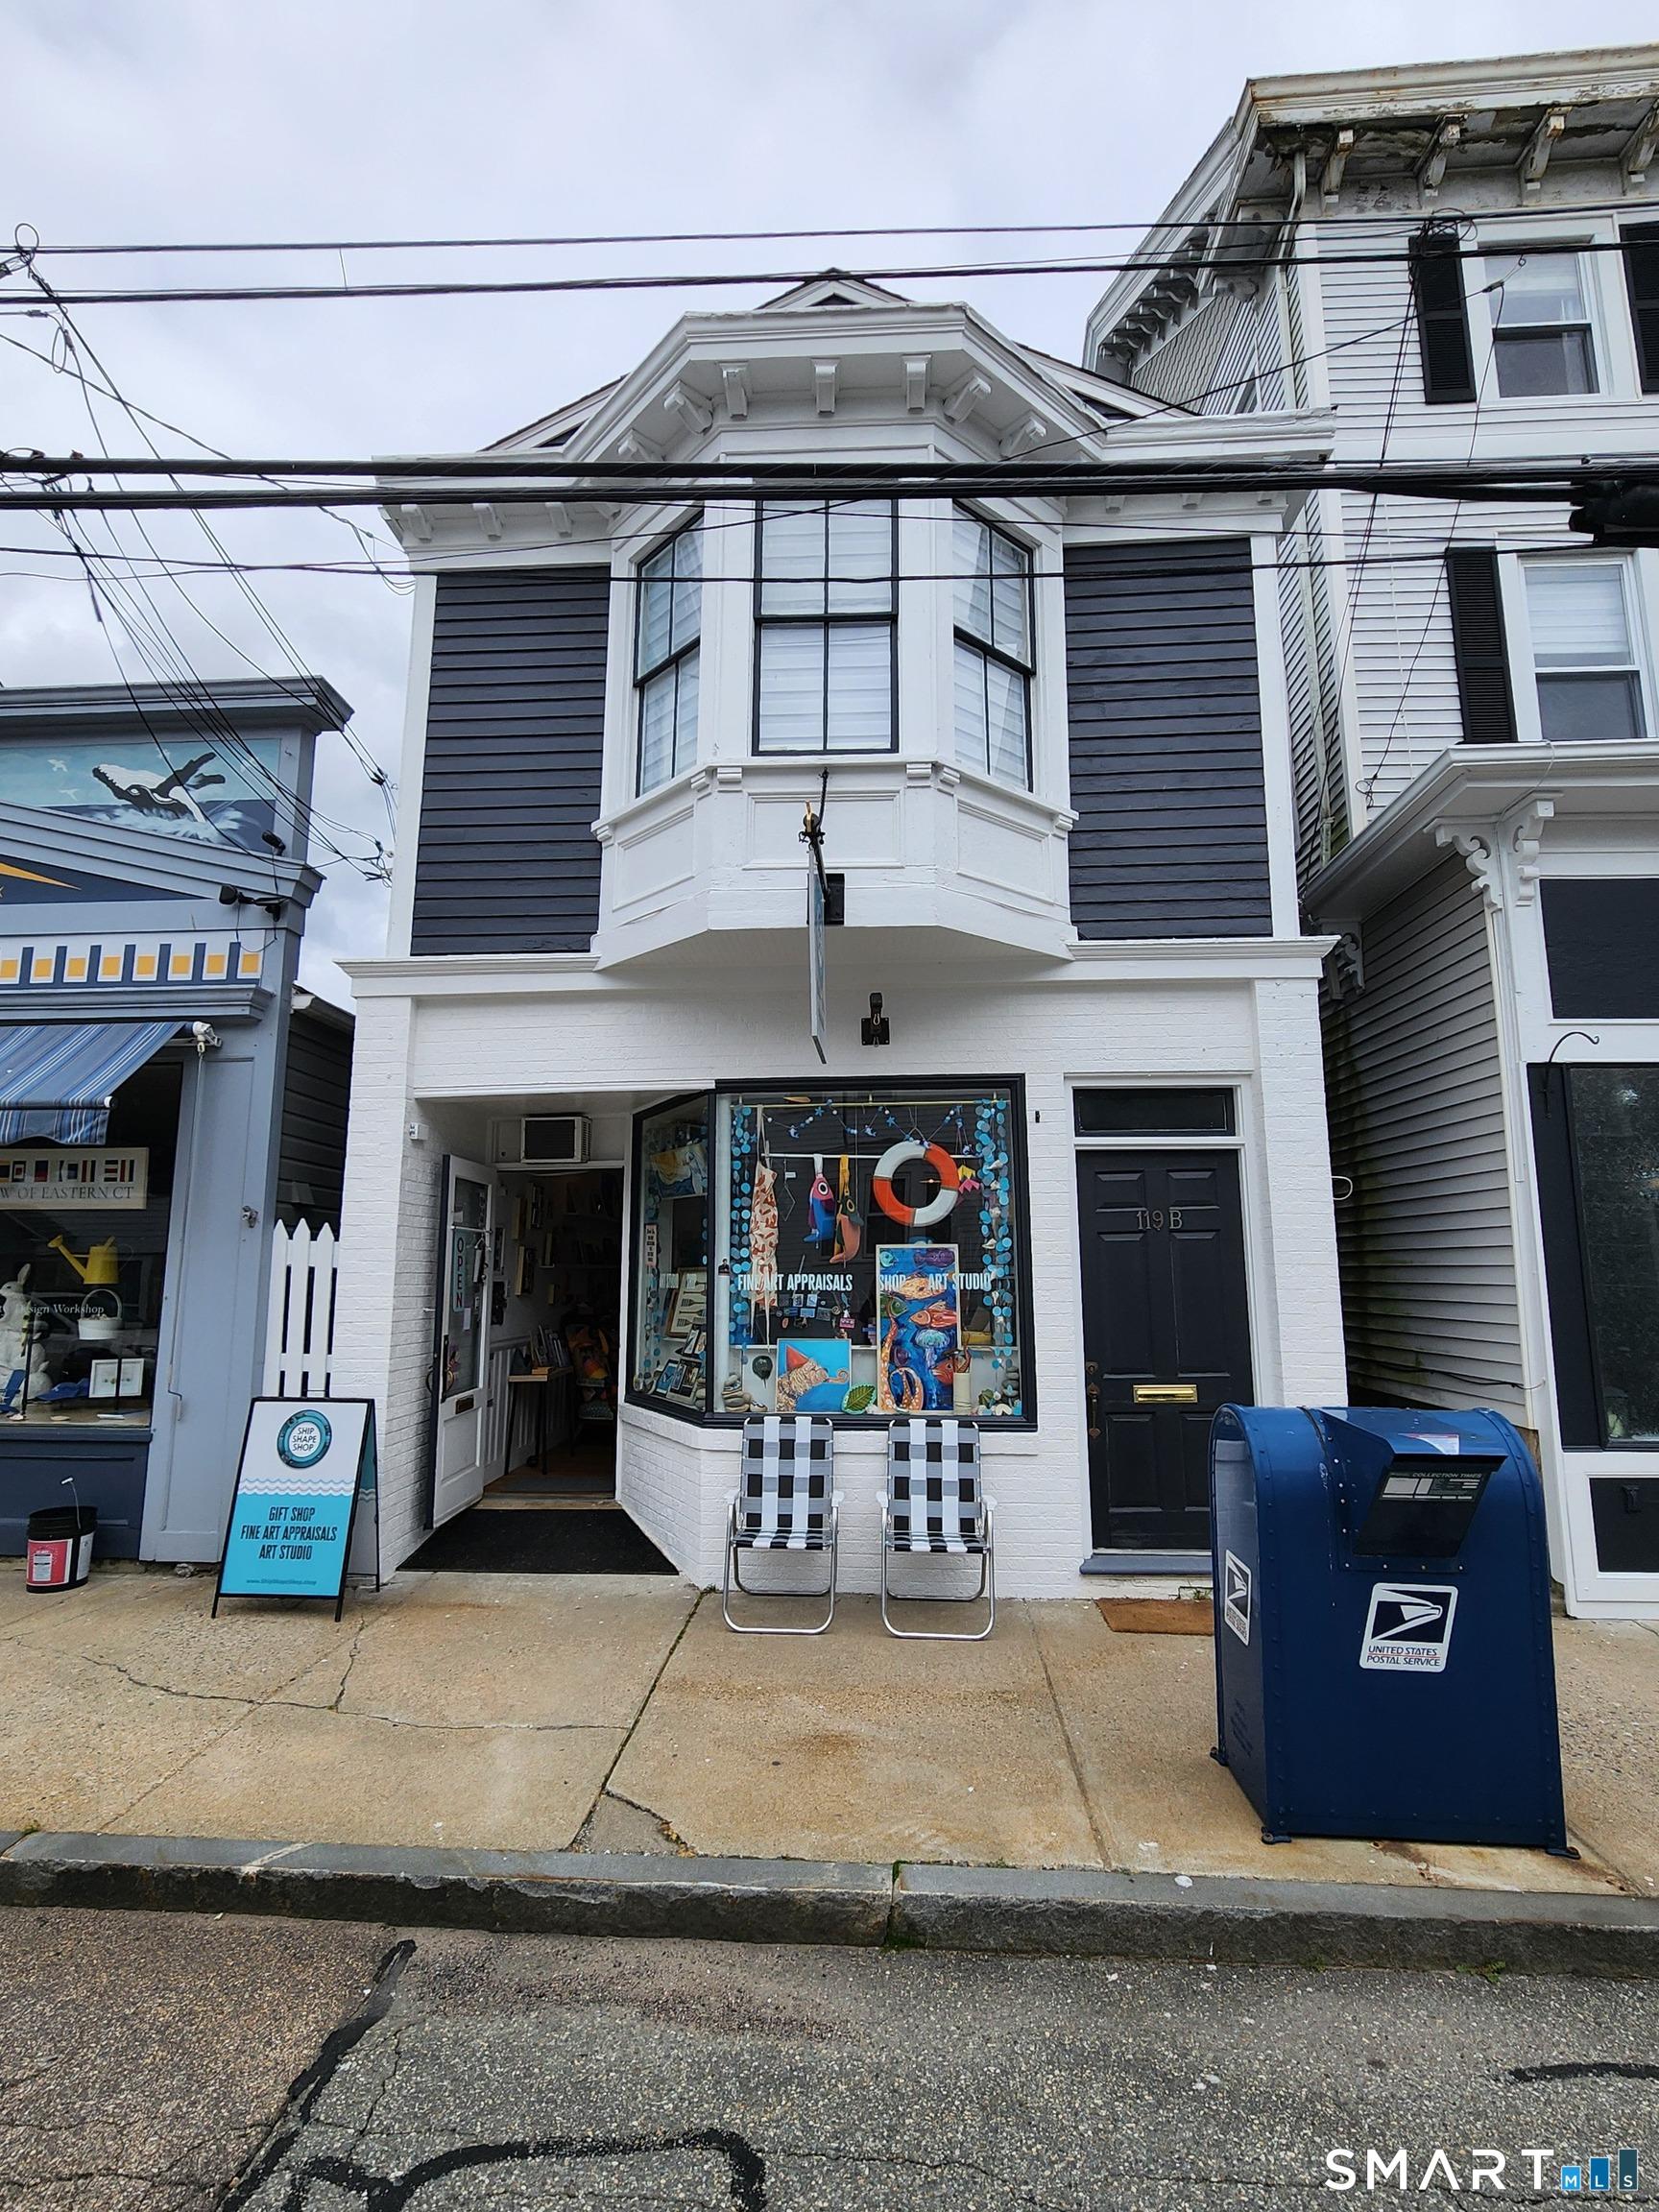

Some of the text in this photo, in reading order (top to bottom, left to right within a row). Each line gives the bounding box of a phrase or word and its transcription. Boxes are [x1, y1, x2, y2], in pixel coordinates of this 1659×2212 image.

[17, 1187, 36, 1199] OF
[42, 1187, 108, 1199] EASTERN
[112, 1186, 134, 1199] CT
[1136, 1210, 1183, 1230] 119 B
[456, 1238, 465, 1308] OPEN
[737, 1273, 854, 1291] FINE ART APPRAISALS
[878, 1273, 906, 1292] SHOP
[928, 1272, 993, 1292] ART STUDIO
[54, 1304, 105, 1315] Workshop
[298, 1427, 315, 1435] SHIP
[292, 1435, 317, 1444] SHAPE
[292, 1443, 314, 1452] SHOP
[269, 1506, 316, 1522] GIFT SHOP
[240, 1525, 338, 1542] FINE ART APPRAISALS
[258, 1544, 313, 1561] ART STUDIO
[1368, 1645, 1438, 1656] UNITED STATES
[1366, 1655, 1441, 1667] POSTAL SERVICE
